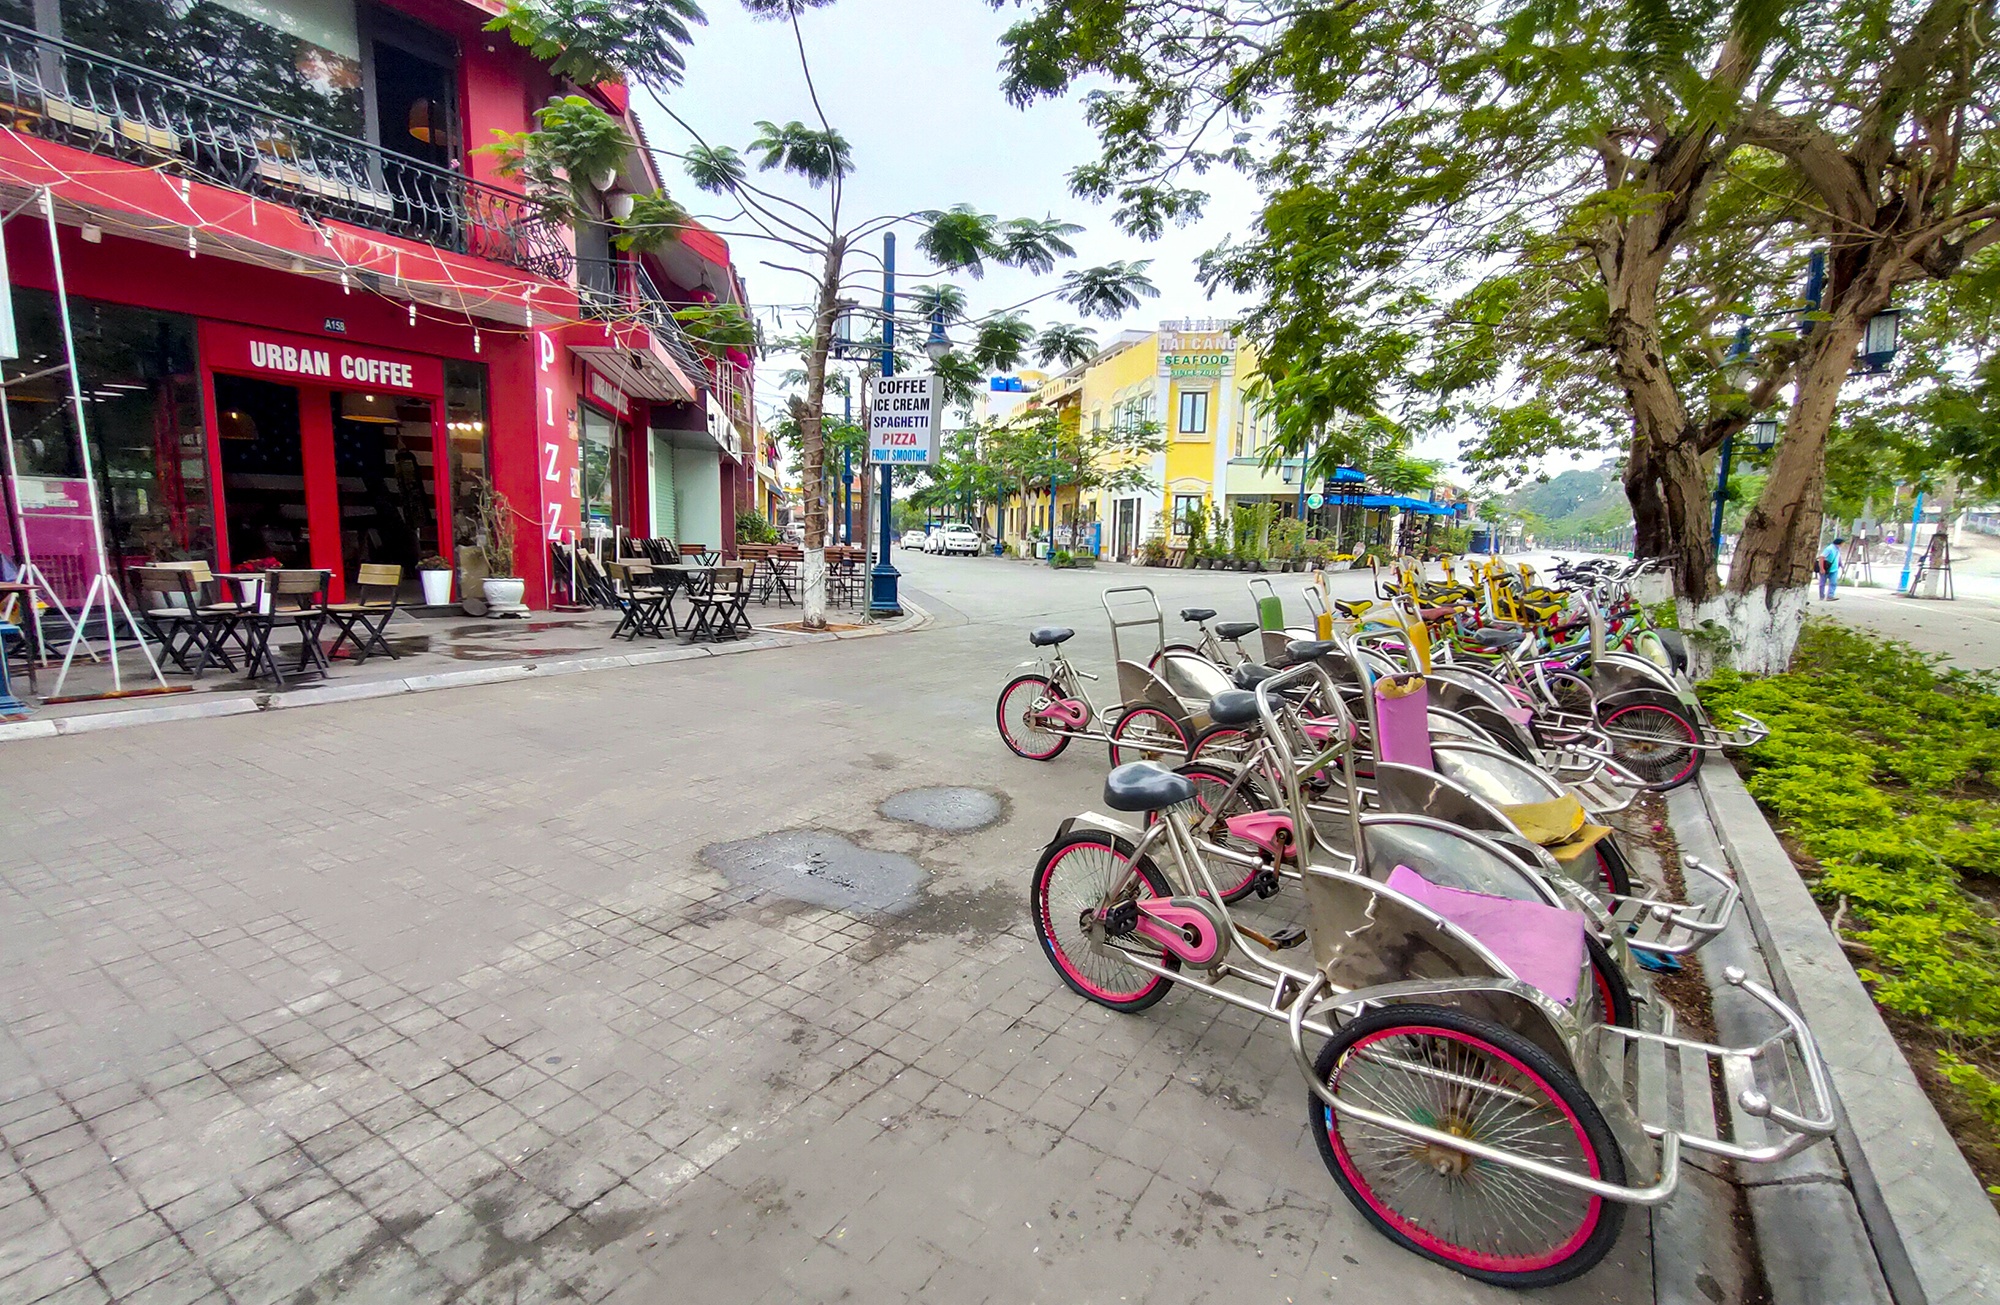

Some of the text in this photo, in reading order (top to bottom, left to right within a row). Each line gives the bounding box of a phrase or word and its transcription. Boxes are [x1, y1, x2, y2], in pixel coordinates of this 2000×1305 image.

[250, 340, 413, 388] URBAN COFFEE
[1164, 354, 1229, 365] SEAFOOD
[878, 379, 926, 395] COFFEE
[873, 397, 930, 412] ICE CREAM
[873, 415, 928, 428] SPAGHETTI
[882, 432, 917, 446] PIZZA
[871, 449, 927, 462] FRUIT SMOOTHIE
